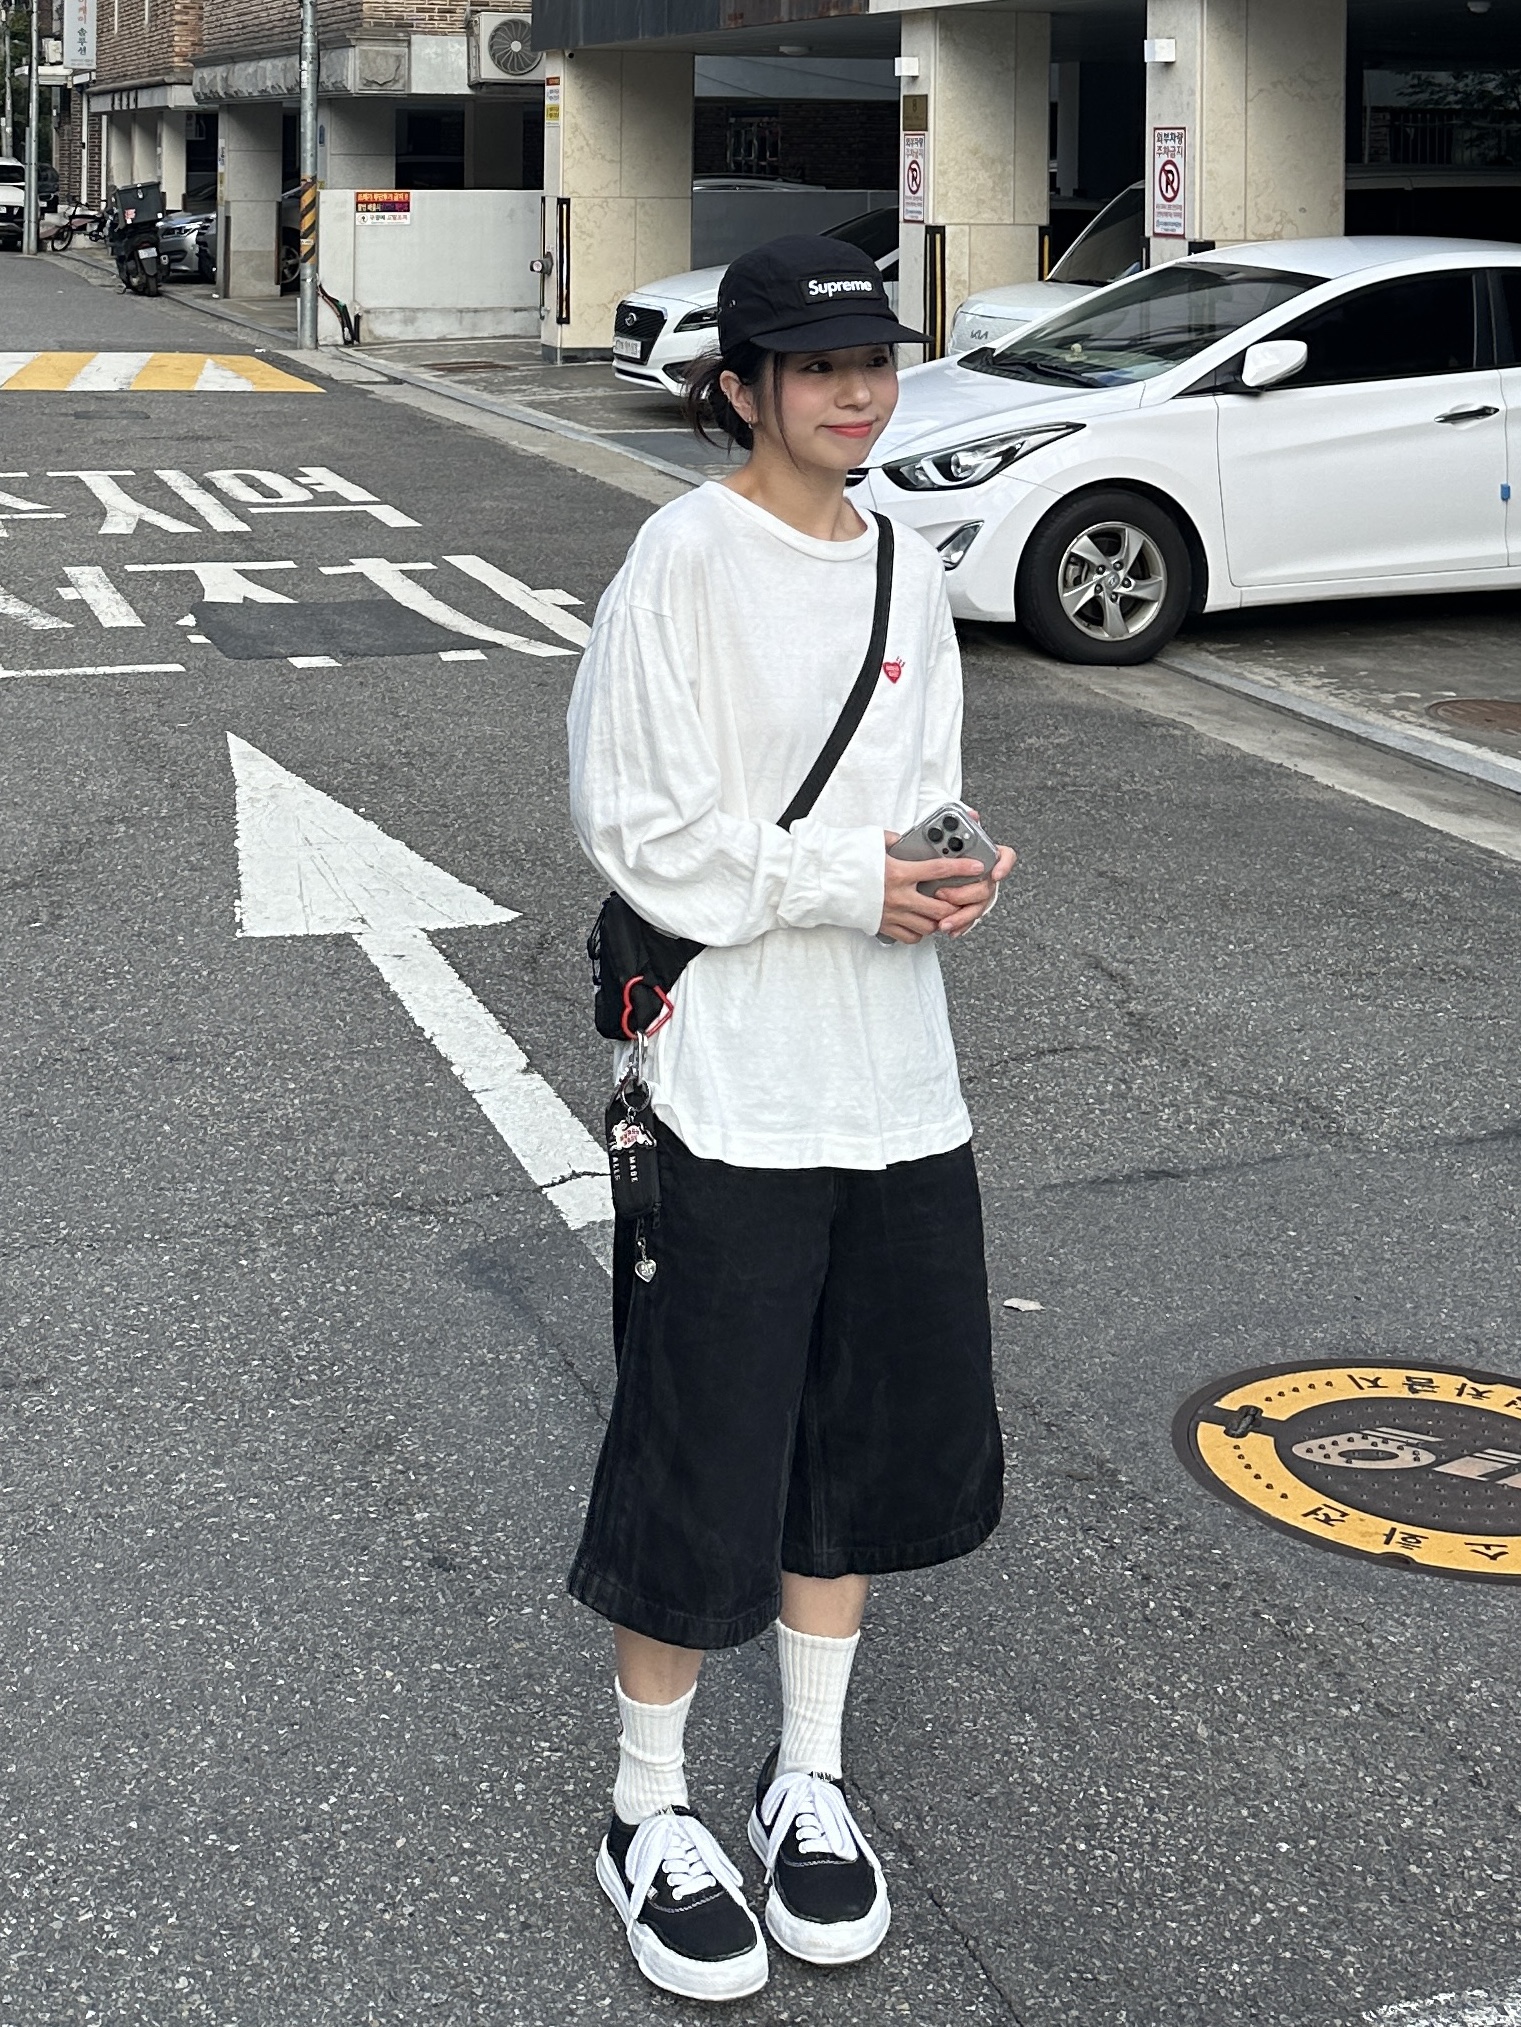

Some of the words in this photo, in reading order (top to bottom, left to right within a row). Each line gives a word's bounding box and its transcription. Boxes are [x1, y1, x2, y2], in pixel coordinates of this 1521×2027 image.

[77, 27, 88, 56] 솔루션
[905, 137, 924, 148] 외부차량
[1156, 131, 1184, 145] 외부차량
[904, 148, 924, 160] 주차금지
[1155, 145, 1183, 158] 주차금지
[808, 280, 873, 297] Supreme
[1301, 1503, 1509, 1561] 소화전
